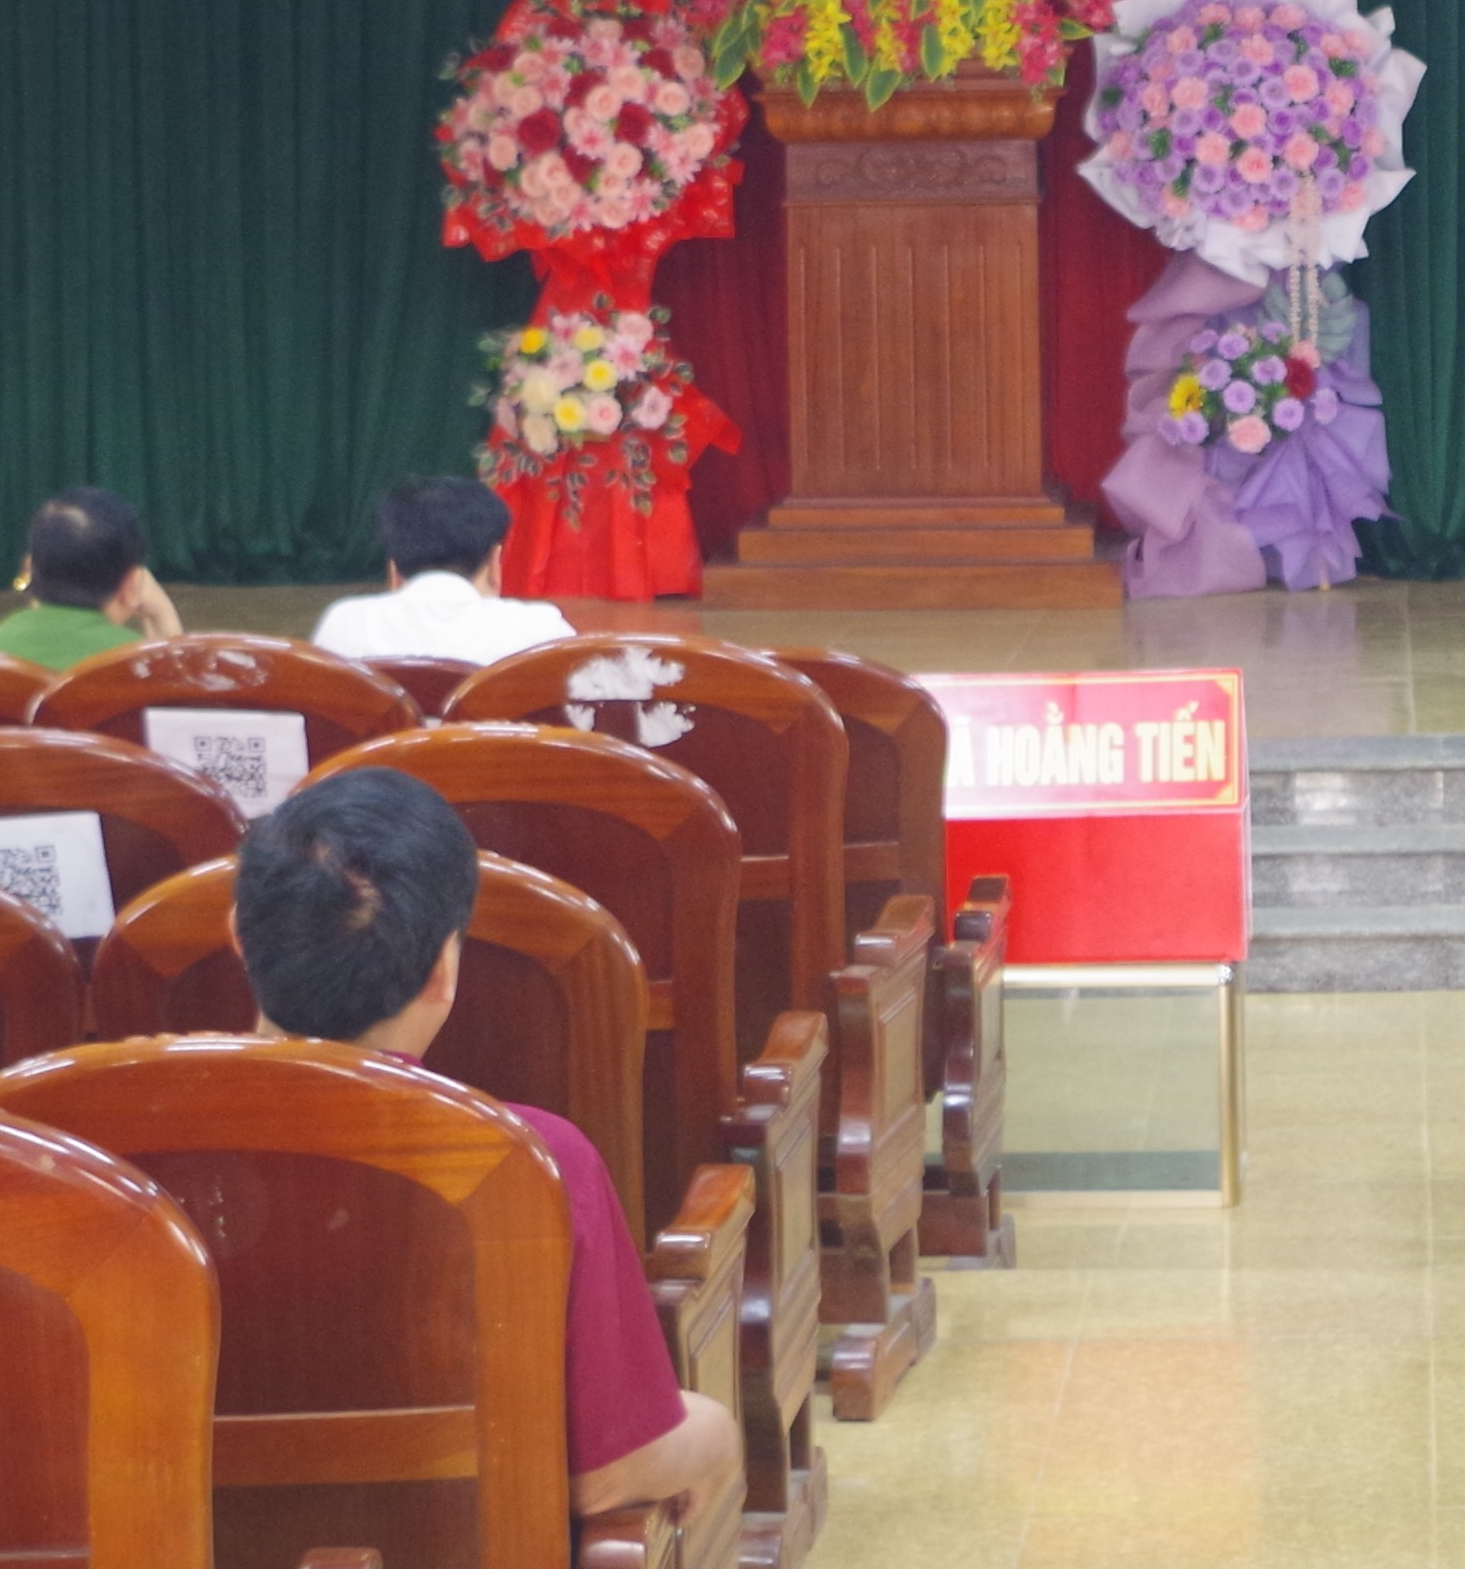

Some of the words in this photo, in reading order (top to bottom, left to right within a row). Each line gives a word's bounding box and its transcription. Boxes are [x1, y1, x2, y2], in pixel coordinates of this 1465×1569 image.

[946, 714, 975, 788] Ã
[984, 701, 1125, 786] HOẰNG
[1136, 700, 1226, 783] TIẾN
